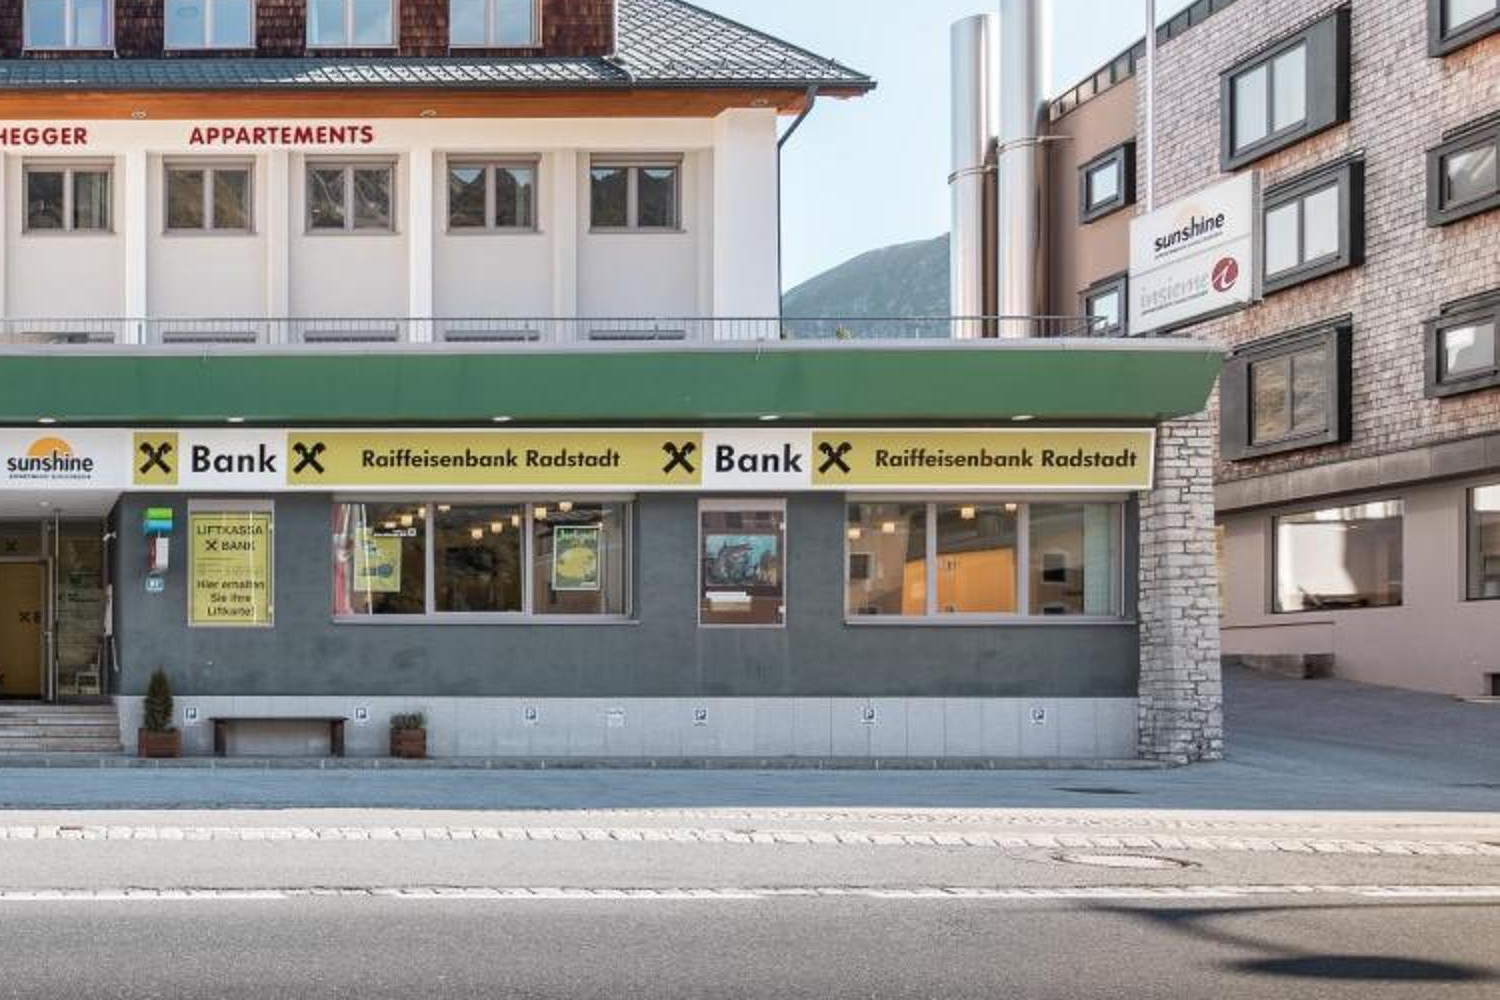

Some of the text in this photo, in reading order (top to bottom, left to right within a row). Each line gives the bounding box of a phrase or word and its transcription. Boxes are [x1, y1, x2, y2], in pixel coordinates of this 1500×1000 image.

[189, 125, 373, 145] APPARTEMENTS
[1154, 212, 1225, 252] sunshine
[6, 449, 94, 471] sunshine
[191, 444, 277, 473] Bank
[362, 448, 620, 467] Raiffeisenbank Radstadt
[715, 444, 802, 473] Bank
[875, 448, 1137, 467] Raiffeisenbank Radstadt
[221, 541, 255, 551] BANK
